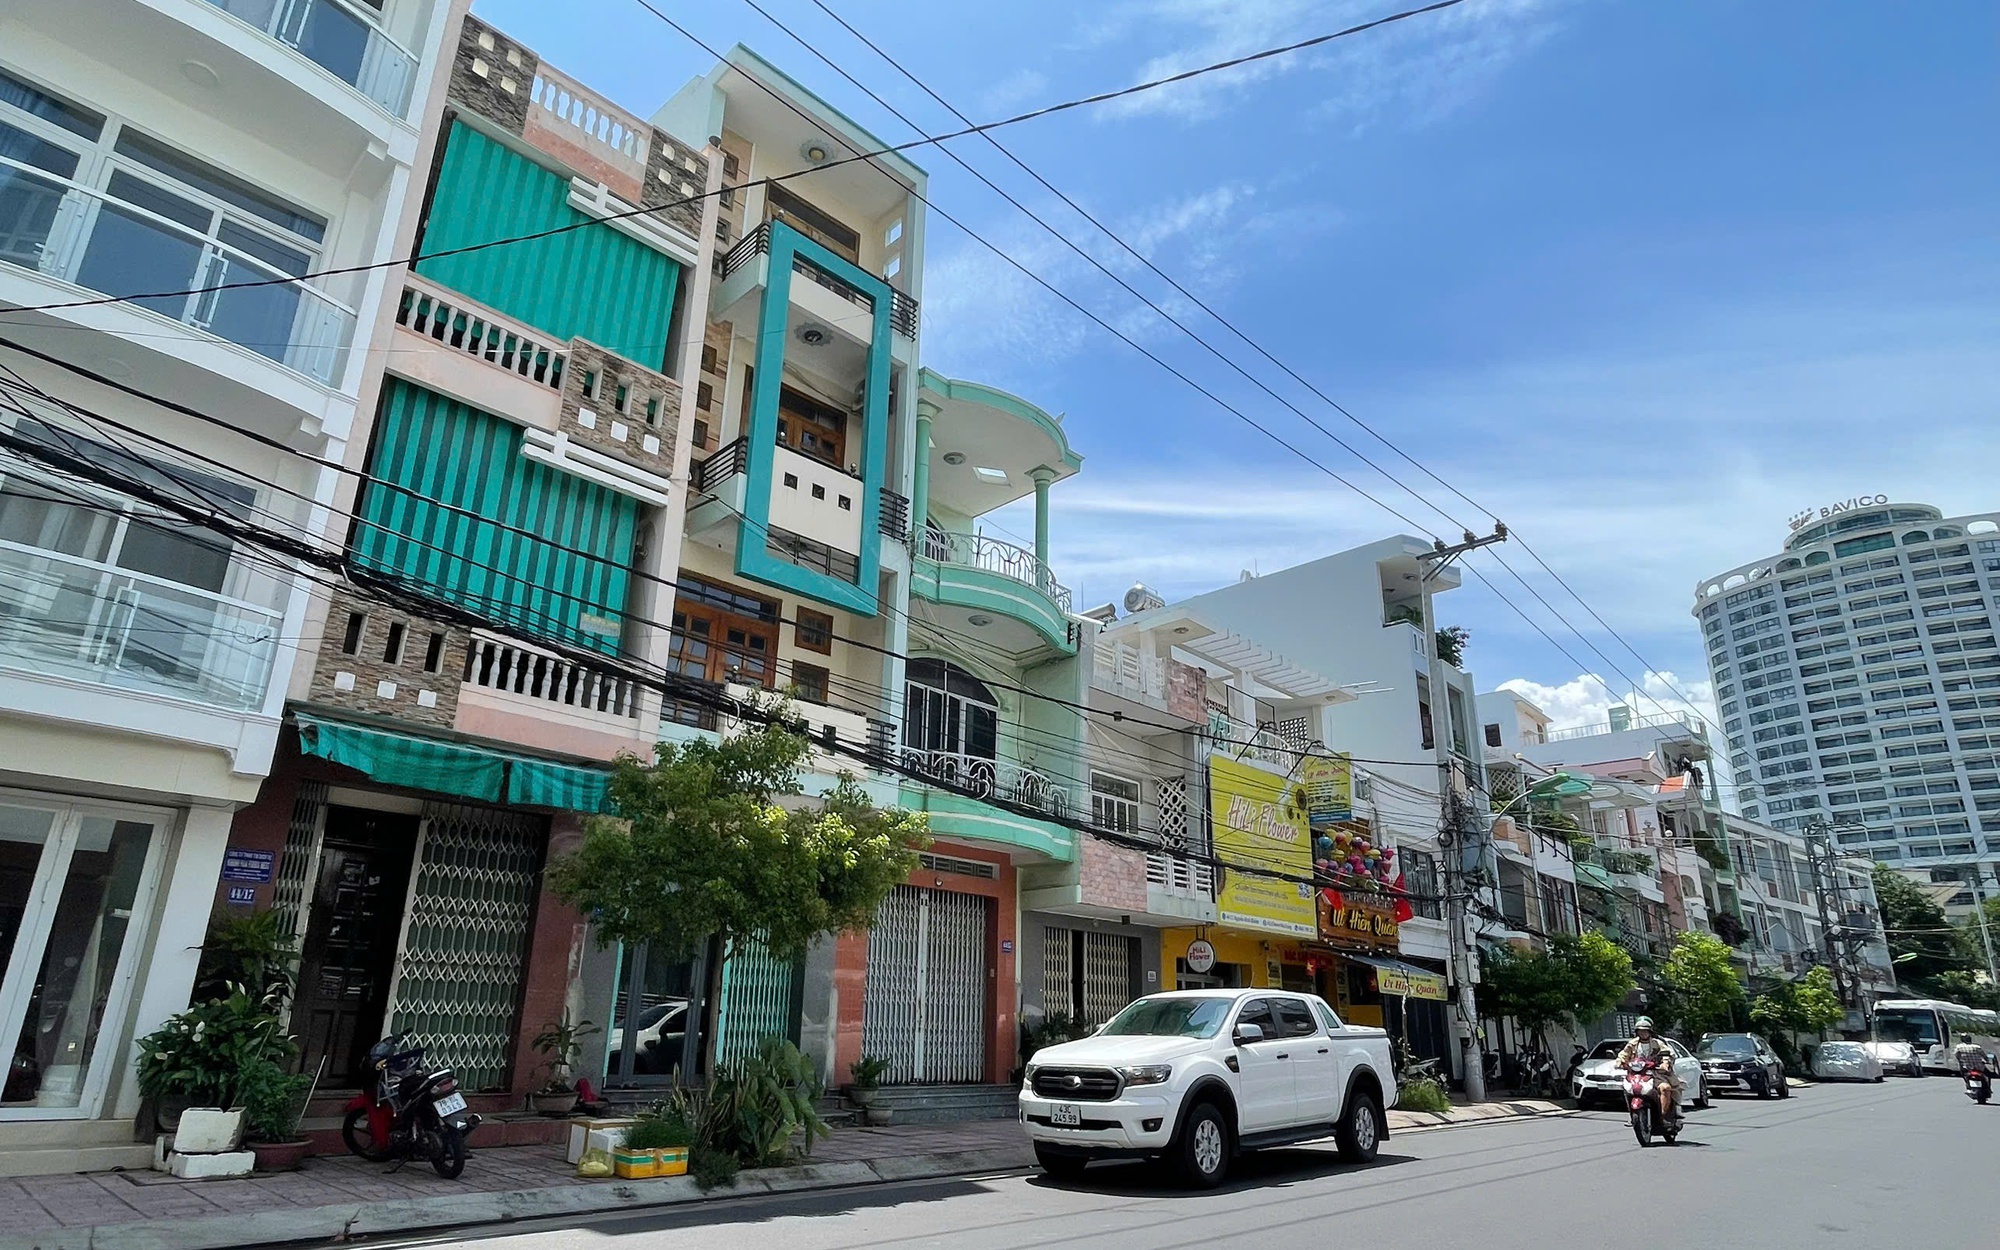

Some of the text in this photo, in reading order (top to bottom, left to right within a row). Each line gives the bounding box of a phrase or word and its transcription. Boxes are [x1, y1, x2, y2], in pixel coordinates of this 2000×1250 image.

[1819, 493, 1888, 518] BAVICO
[1227, 794, 1299, 842] HiLi Flower
[231, 888, 255, 900] 44/17
[1058, 1104, 1072, 1114] 43C
